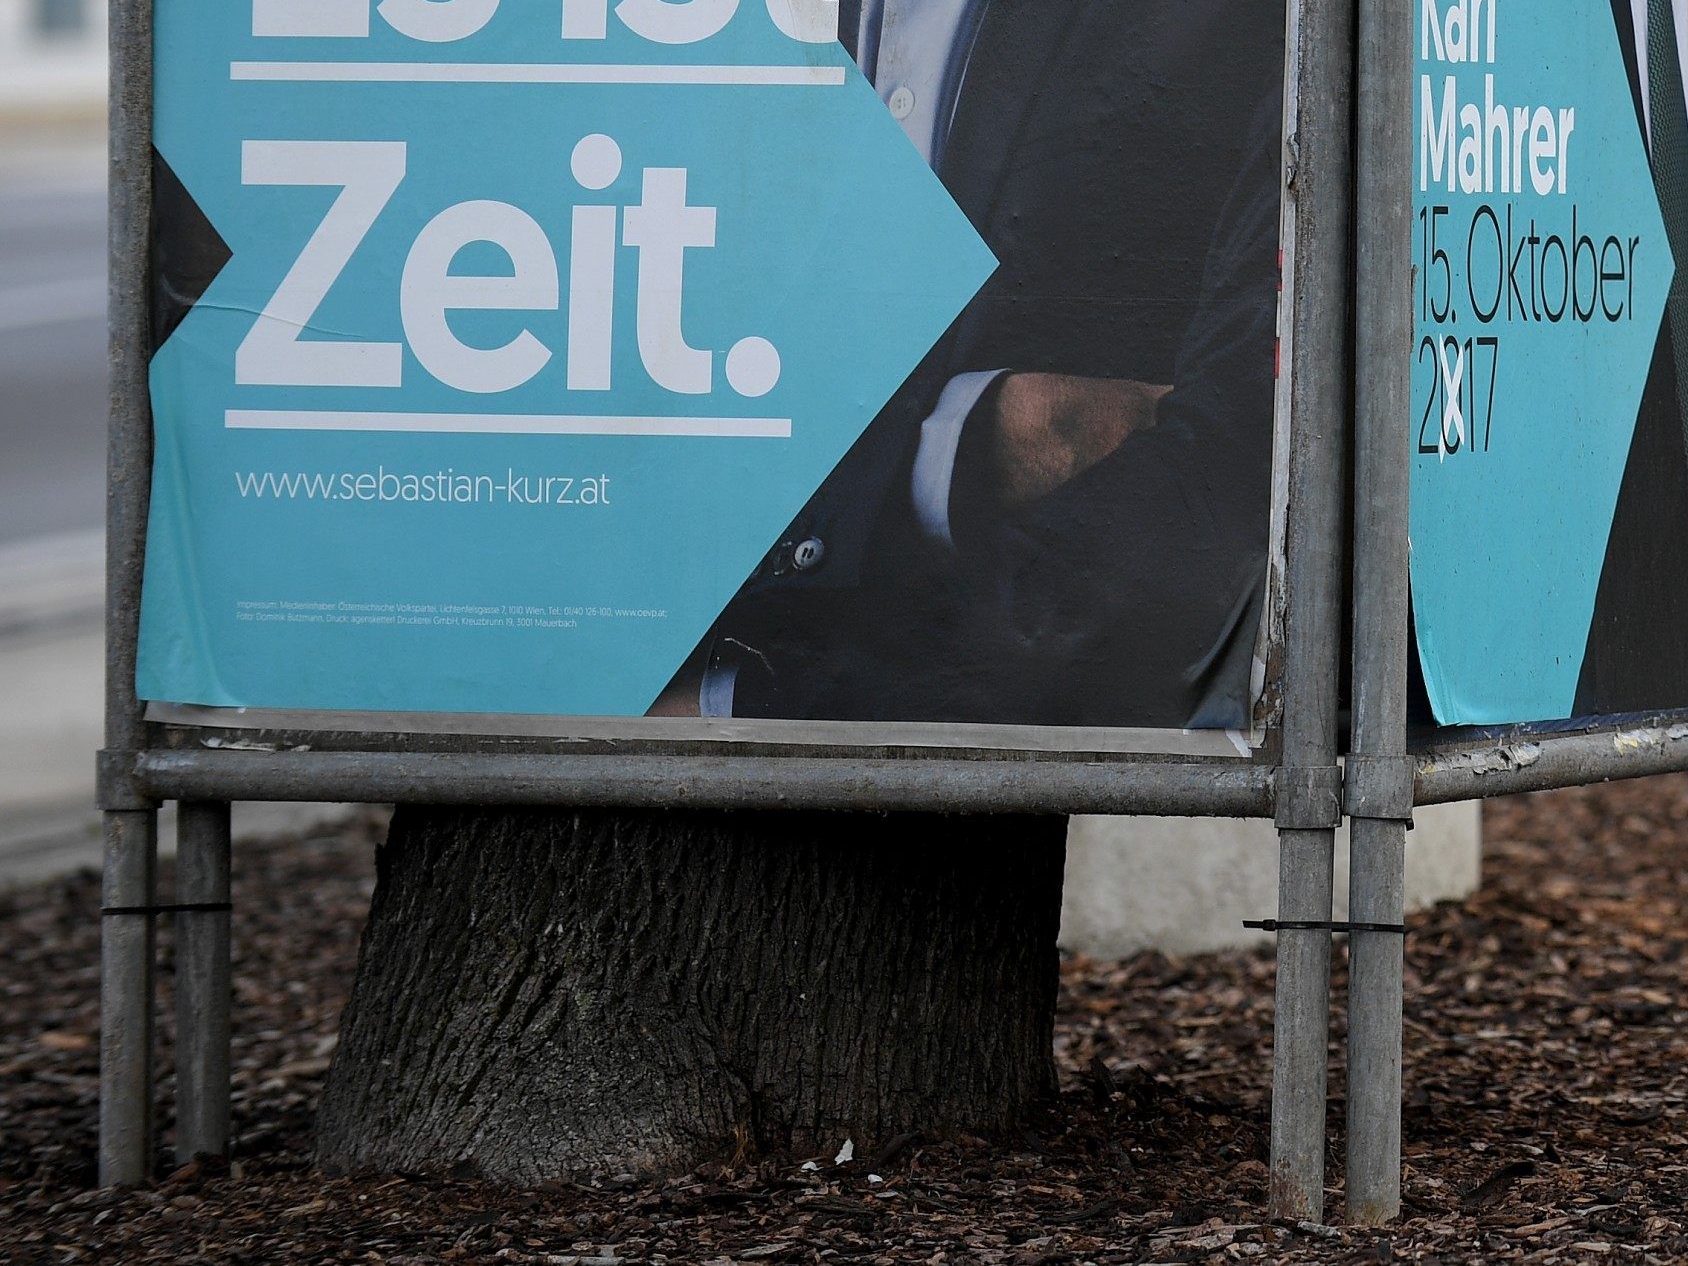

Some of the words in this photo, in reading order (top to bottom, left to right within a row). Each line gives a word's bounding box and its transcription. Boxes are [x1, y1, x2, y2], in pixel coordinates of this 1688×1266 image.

[1420, 74, 1575, 196] Mahrer
[234, 133, 782, 398] Zeit.
[1419, 204, 1456, 324] 15.
[1467, 203, 1640, 324] Oktober
[1418, 333, 1499, 458] 2017
[235, 465, 611, 505] www.sebastian-kurz.at
